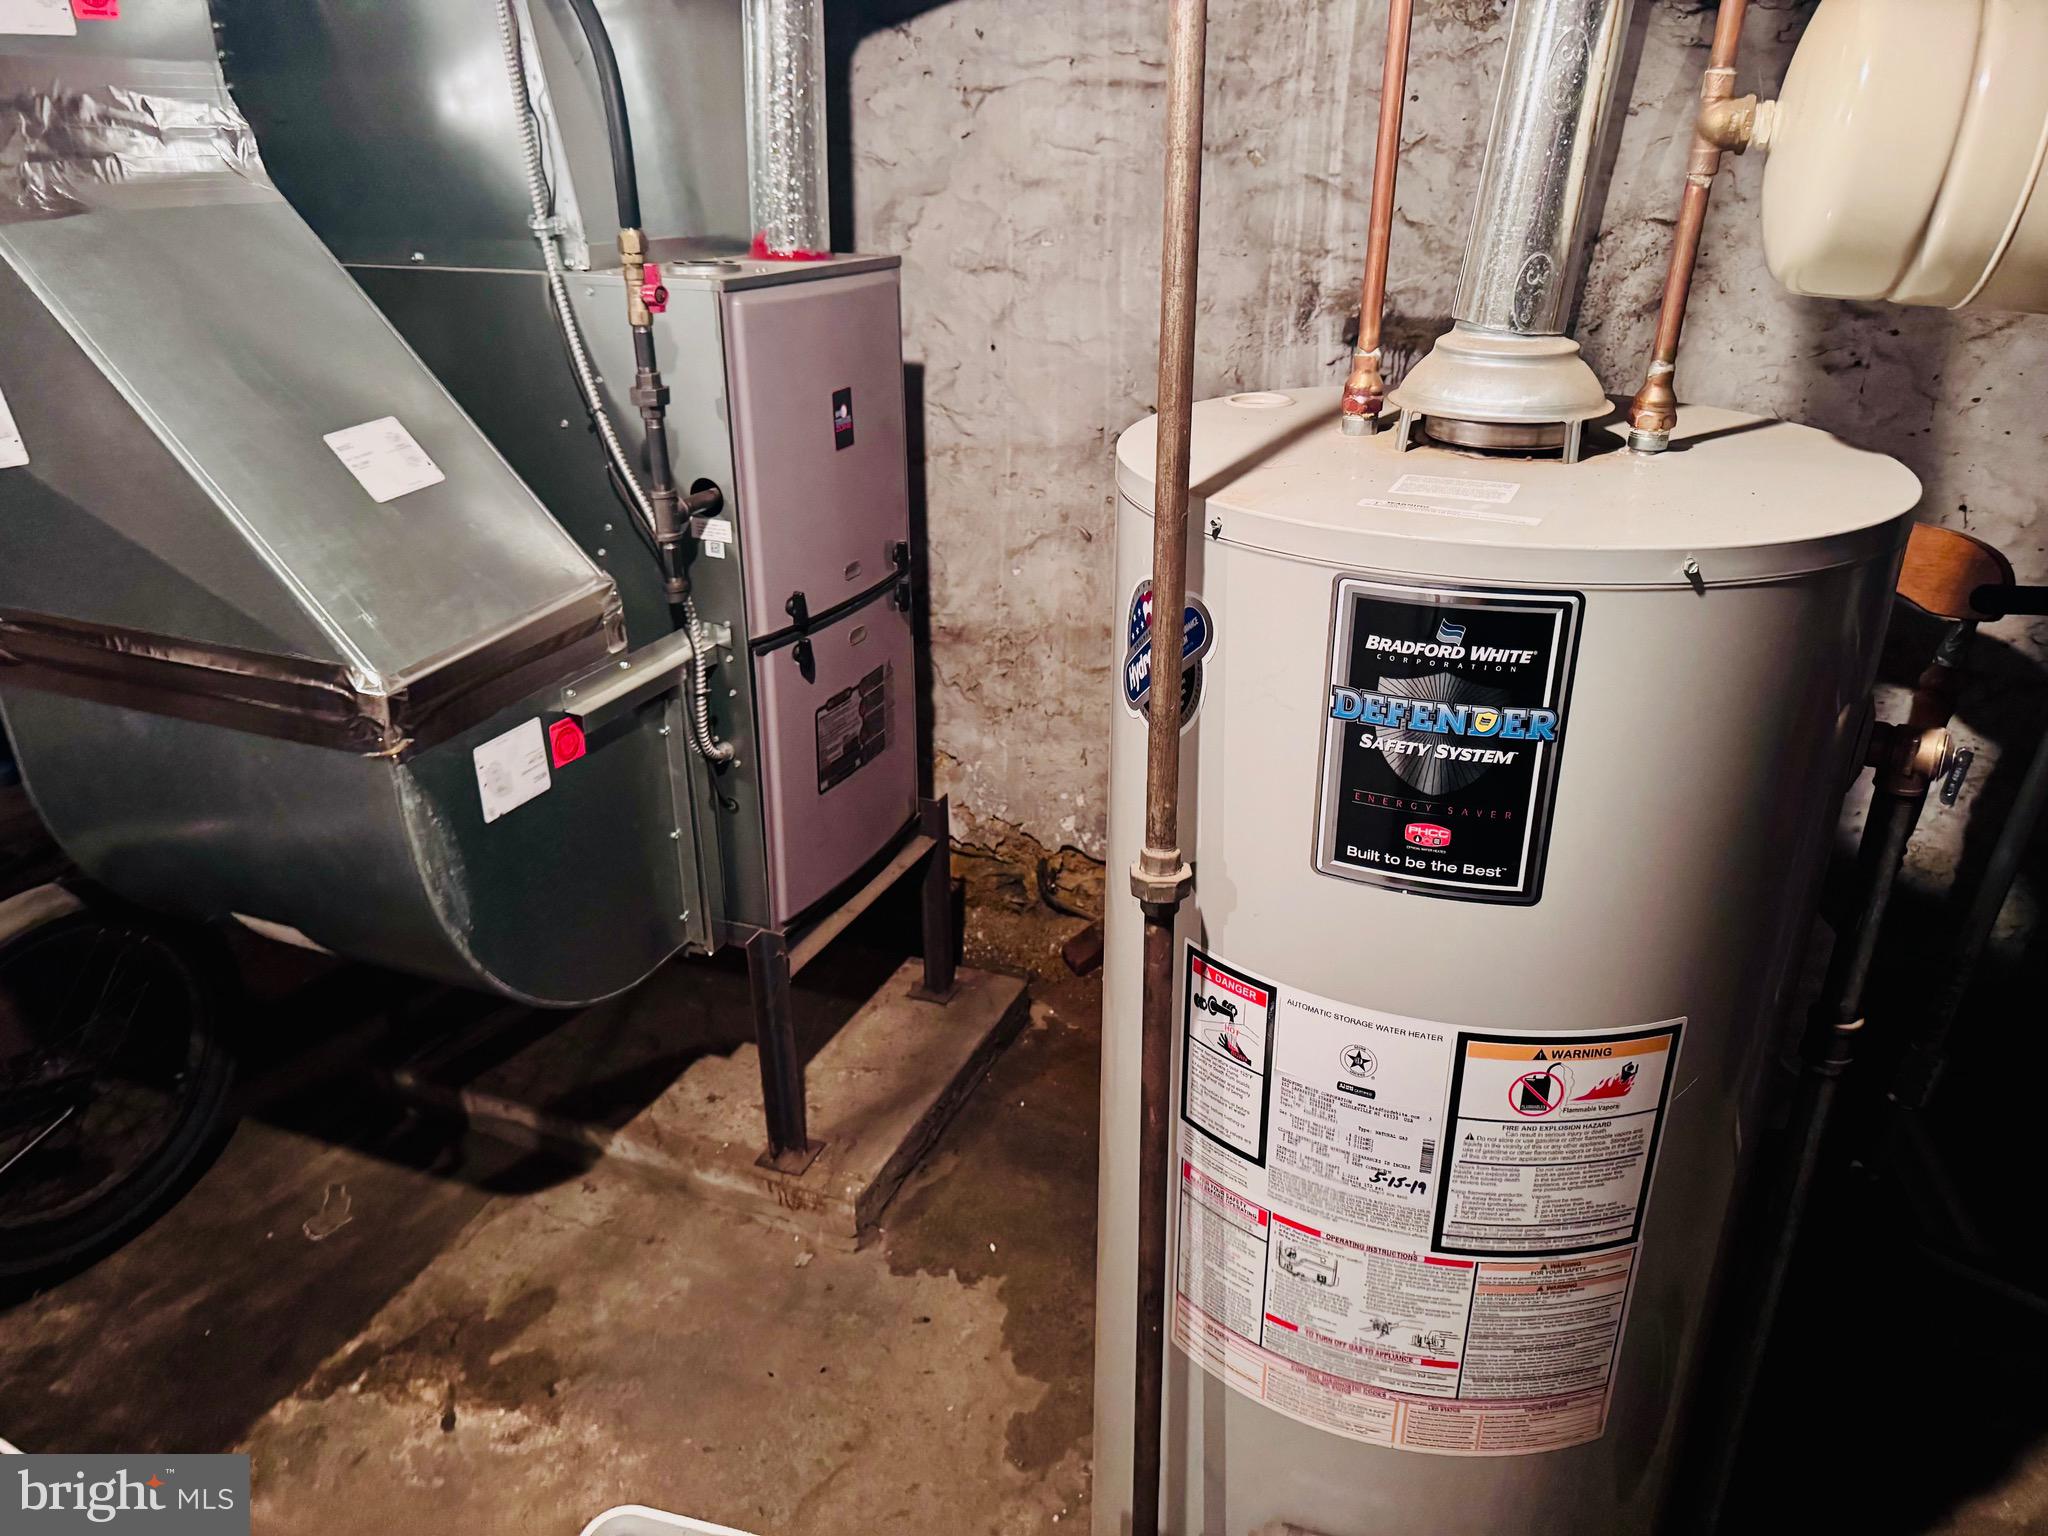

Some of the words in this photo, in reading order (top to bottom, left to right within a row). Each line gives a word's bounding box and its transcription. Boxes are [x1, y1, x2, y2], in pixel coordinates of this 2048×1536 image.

[1365, 634, 1465, 659] BRADFORD
[1376, 653, 1517, 673] CORPORATION
[1331, 687, 1558, 741] DEFENDER
[1359, 733, 1432, 757] SAFETY
[1434, 744, 1516, 765] SYSTEM
[1354, 792, 1432, 812] ENERGY
[1447, 806, 1512, 820] SAVER
[1408, 826, 1449, 838] PHCC
[1346, 845, 1381, 863] Built
[1384, 852, 1400, 866] to
[1405, 855, 1426, 869] be
[1430, 860, 1457, 873] the
[1462, 863, 1501, 878] Best
[1215, 973, 1257, 1001] DANGER
[1224, 1023, 1239, 1036] HOT
[1286, 998, 1332, 1018] AUTOMATIC
[1333, 1013, 1374, 1029] STORAGE
[1375, 1024, 1406, 1036] WATER
[1408, 1031, 1444, 1042] HEATER
[1551, 1047, 1613, 1059] WARNING
[1599, 1104, 1620, 1112] Vapors
[1582, 1121, 1612, 1129] HAZARD
[1368, 1171, 1427, 1195] 5-15-19
[1325, 1232, 1365, 1251] OPERATING
[1365, 1245, 1418, 1261] INSTRUCTIONS
[1550, 1261, 1582, 1269] WARNING
[1564, 1266, 1587, 1274] SAFETY
[1315, 1332, 1333, 1345] TURN
[1334, 1339, 1347, 1348] OFF
[1348, 1343, 1363, 1353] GAS
[1365, 1347, 1374, 1355] TO
[1375, 1350, 1414, 1364] APPLIANCE
